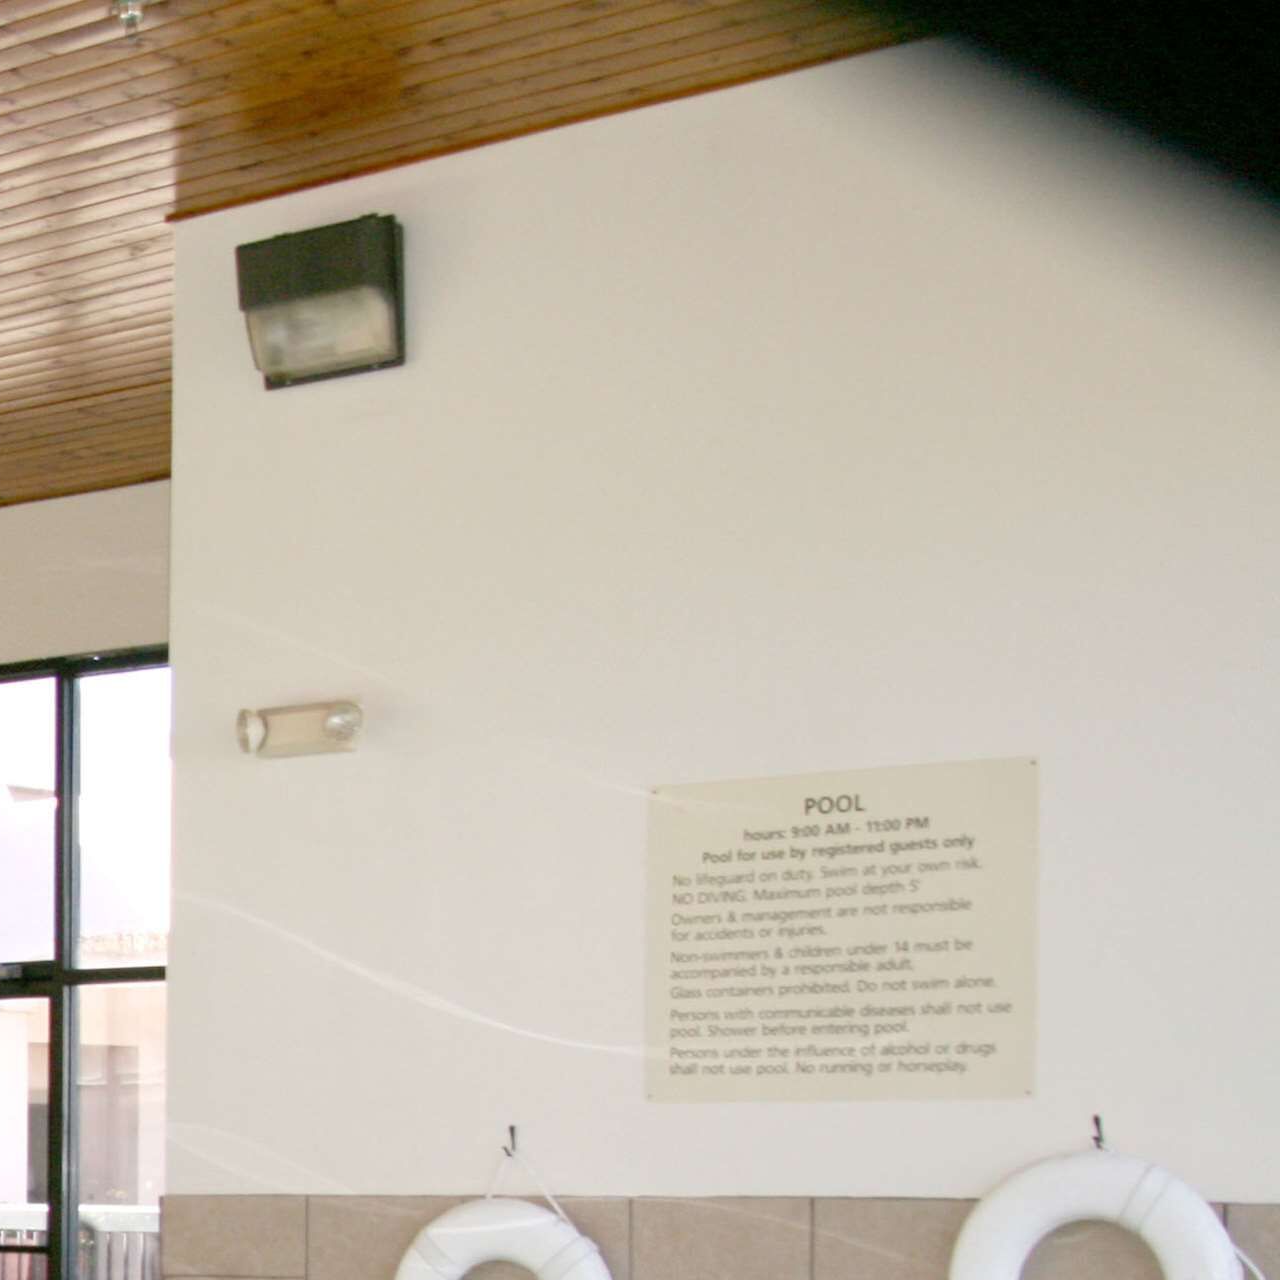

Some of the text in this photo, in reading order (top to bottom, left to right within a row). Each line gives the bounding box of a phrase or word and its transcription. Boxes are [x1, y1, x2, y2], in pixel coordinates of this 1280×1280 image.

[804, 794, 866, 816] POOL
[743, 829, 786, 841] hours:
[791, 825, 821, 838] 9:00
[825, 822, 851, 834] AM
[867, 819, 901, 832] 11:00
[905, 816, 929, 829] PM
[702, 833, 975, 864] Pool for use by registered guests only
[672, 874, 691, 886] No
[696, 869, 755, 887] lifeguard
[758, 874, 777, 883] on
[820, 865, 858, 878] Swim
[861, 864, 877, 876] at
[880, 863, 912, 876] your
[917, 861, 951, 873] own
[672, 893, 694, 905] NO
[753, 887, 821, 901] Maximum
[825, 884, 857, 899] pool
[861, 880, 905, 897] depth
[671, 898, 973, 926] Owners & management are not responsible
[671, 923, 827, 942] for accidents or injuries.
[671, 950, 769, 964] Non-swimmers
[773, 946, 783, 959] &
[789, 945, 841, 959] children
[846, 942, 888, 956] under
[914, 939, 950, 952] must
[954, 937, 973, 951] be
[670, 963, 757, 980] accompanied
[760, 963, 777, 979] by
[781, 965, 790, 976] a
[794, 959, 870, 975] responsible
[670, 986, 702, 999] Glass
[705, 985, 775, 998] containers
[856, 980, 878, 993] Do
[882, 979, 907, 991] not
[911, 978, 950, 991] swim
[670, 1002, 1013, 1022] Persons with communicable diseases shall not use
[707, 1024, 757, 1037] Shower
[761, 1023, 808, 1036] before
[811, 1022, 870, 1037] entering
[670, 1046, 719, 1059] Persons
[724, 1045, 763, 1059] under
[767, 1045, 790, 1058] the
[795, 1043, 856, 1057] influence
[860, 1042, 876, 1057] of
[880, 1041, 930, 1057] alcohol
[934, 1044, 949, 1055] or
[670, 1061, 699, 1076] shall
[702, 1063, 725, 1075] not
[729, 1064, 753, 1075] use
[795, 1061, 815, 1073] No
[820, 1061, 873, 1077] running
[877, 1062, 891, 1073] or
